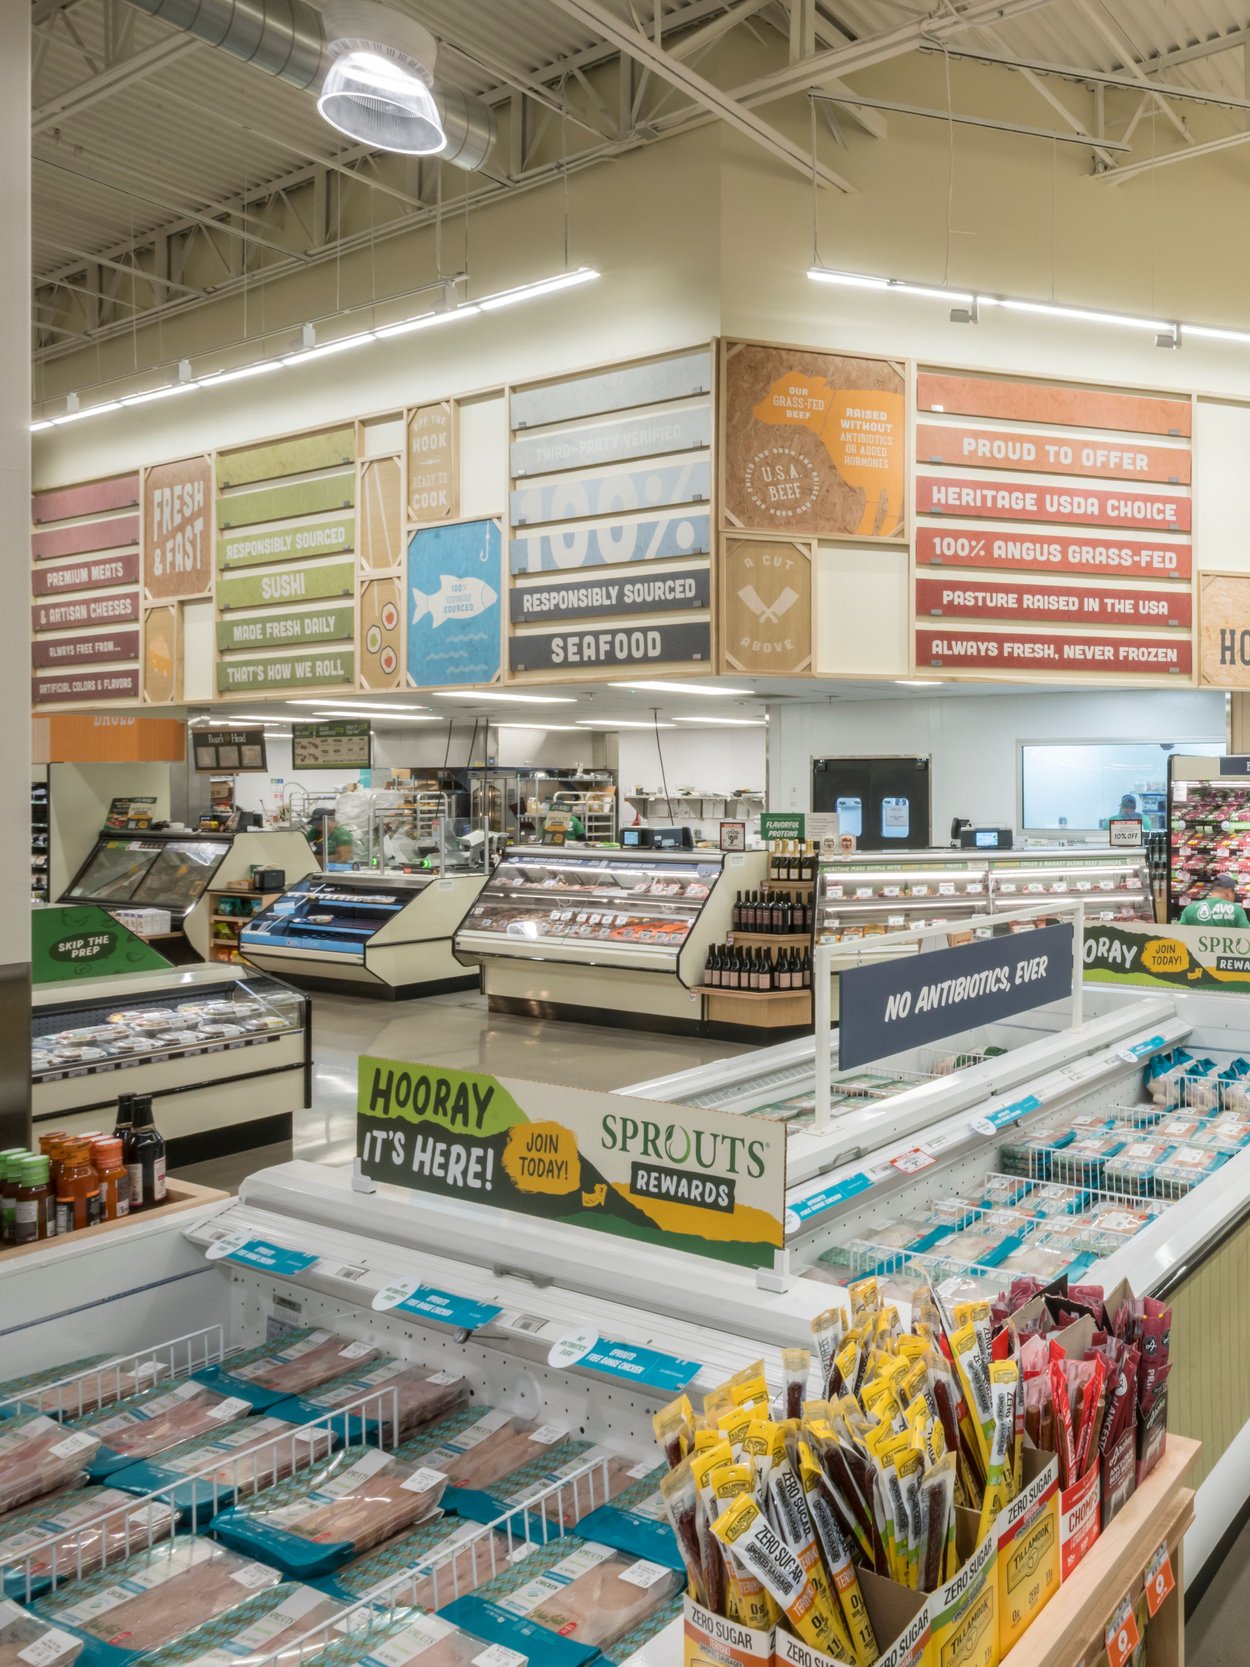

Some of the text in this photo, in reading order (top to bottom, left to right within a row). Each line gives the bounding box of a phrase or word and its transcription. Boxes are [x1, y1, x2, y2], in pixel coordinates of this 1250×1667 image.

[789, 387, 808, 395] OUR
[414, 415, 447, 432] OFF THE
[786, 410, 812, 419] BEEF
[840, 419, 893, 433] WITHOUT
[846, 408, 887, 421] RAISED
[413, 432, 447, 453] HOOK
[535, 424, 682, 462] THIRD-PARTY VERIFIED
[840, 432, 893, 445] ANTIBIOTICS
[845, 444, 888, 457] OR ADDED
[844, 455, 889, 470] HORMONES
[962, 437, 1149, 471] PROUD TO OFFER
[438, 472, 448, 484] TO
[762, 463, 803, 482] U.S.A.
[413, 490, 447, 510] COOK
[768, 482, 801, 501] BEEF
[931, 485, 1177, 521] HERITAGE USDA CHOICE
[153, 480, 204, 543] FRESH
[521, 462, 695, 572] 100%
[154, 517, 204, 576] & FAST
[226, 527, 346, 560] RESPONSIBLY SOURCED
[932, 536, 1177, 569] 100% ANGUS GRASS-FED
[47, 561, 123, 587] PREMIUM MEATS
[744, 554, 794, 570] A CUT
[261, 572, 306, 599] SUSHI
[523, 578, 696, 613] RESPONSIBLY SOURCED
[40, 598, 132, 624] & ARTISAN CHEESES
[443, 603, 474, 614] SOURCED
[942, 590, 1168, 615] PASTURE RAISED IN THE USA
[233, 616, 336, 641] MADE FRESH DAILY
[49, 645, 75, 657] ALWAYS
[76, 643, 93, 655] FREE
[551, 630, 662, 664] SEAFOOD
[741, 636, 794, 653] ABOVE
[931, 639, 1178, 662] ALWAYS FRESH, NEVER FROZEN
[227, 659, 345, 683] THAT'S HOW WE ROLL
[39, 677, 132, 694] ARTIFICIAL COLORS & FLAVORS
[230, 732, 246, 743] Head
[768, 830, 798, 838] PROTEINS
[58, 935, 110, 952] SKIP THE
[71, 945, 100, 959] PREP
[1081, 937, 1138, 969] ORAY
[1155, 944, 1176, 955] JOIN
[1151, 955, 1182, 967] TODAY!
[884, 955, 1049, 1023] NO ANTIBIOTICS, EVER
[369, 1067, 495, 1130] HOORAY
[525, 1131, 559, 1154] JOIN
[600, 1113, 767, 1180] SPROUTS
[362, 1129, 495, 1191] IT'S HERE!
[519, 1154, 569, 1181] TODAY!
[635, 1169, 730, 1207] REWARDS
[585, 1353, 602, 1363] FREE
[617, 1361, 646, 1375] CHICKEN
[782, 1469, 811, 1537] ZERO SUGAR
[1008, 1468, 1052, 1525] ZERO SUGAR
[1068, 1483, 1098, 1533] CHOMPS
[813, 1499, 827, 1528] SMOKED
[748, 1543, 769, 1569] SMOKED
[755, 1524, 803, 1585] ZERO SUGAR
[1013, 1522, 1049, 1570] TILLAMOOK
[944, 1537, 993, 1606] ZERO SUGAR
[691, 1606, 752, 1650] ZERO SUGAR
[899, 1608, 929, 1658] SUGAR
[951, 1597, 989, 1655] TILLAMOOK
